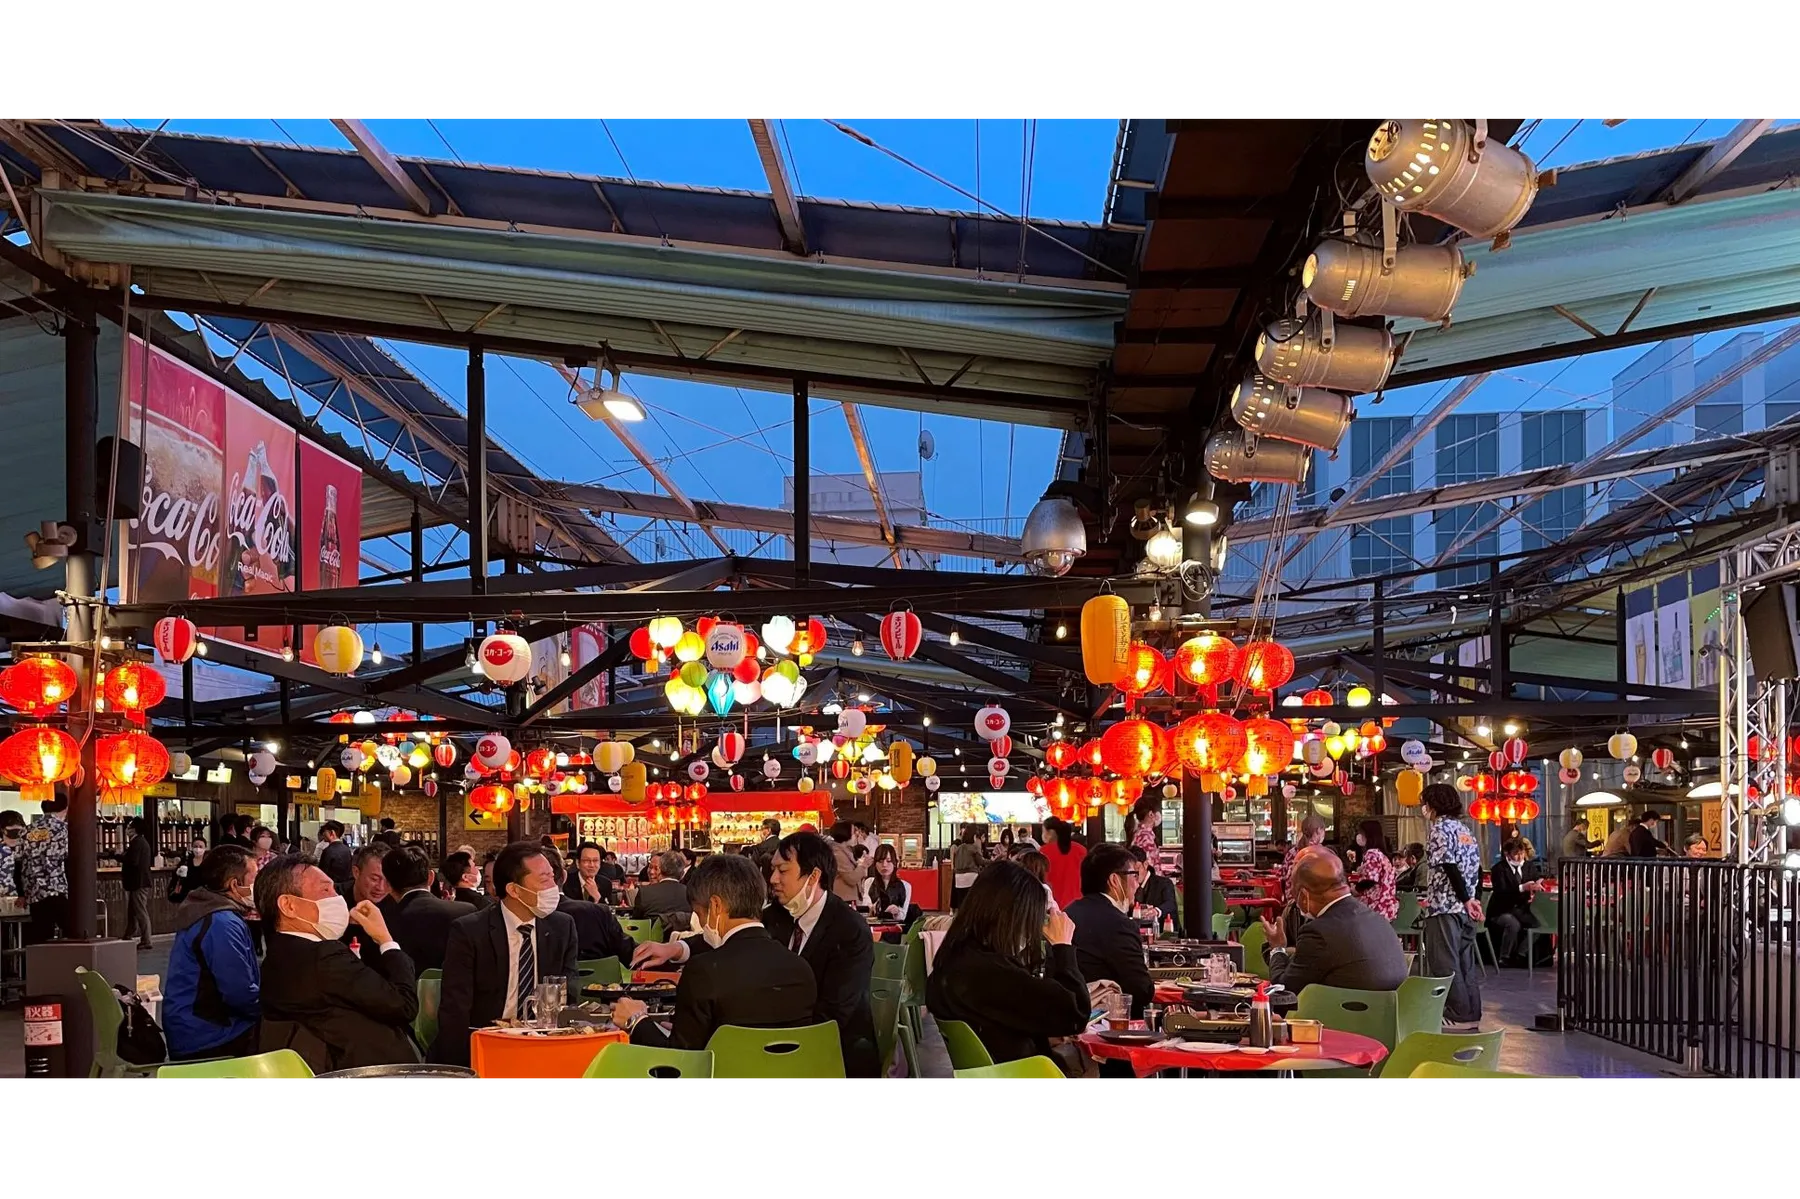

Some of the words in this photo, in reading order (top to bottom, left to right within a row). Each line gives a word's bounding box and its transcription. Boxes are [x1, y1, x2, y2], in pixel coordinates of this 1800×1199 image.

[227, 472, 290, 563] Coca-Cola
[237, 561, 255, 574] Real
[254, 567, 273, 582] Magic
[711, 640, 739, 651] Asahi
[1711, 820, 1722, 851] 2
